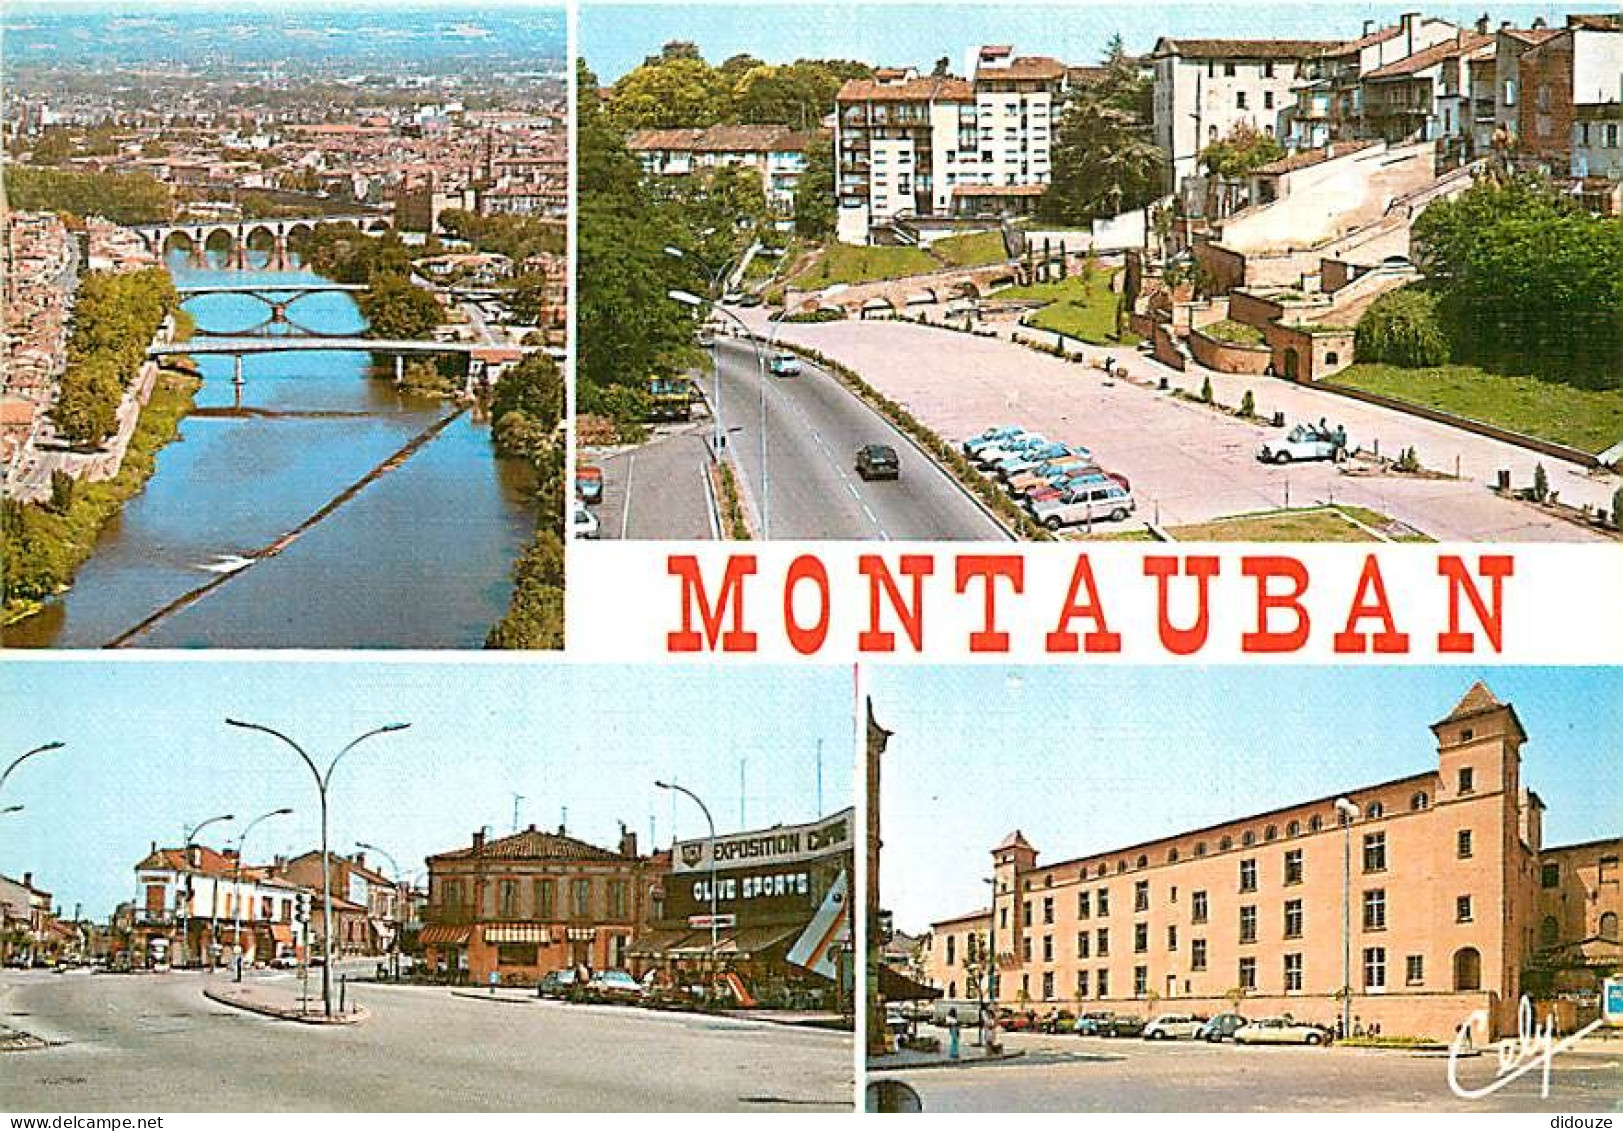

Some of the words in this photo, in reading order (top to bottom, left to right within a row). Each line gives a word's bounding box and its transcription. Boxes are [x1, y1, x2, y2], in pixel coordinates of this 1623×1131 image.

[714, 832, 800, 862] EXPOSITION
[693, 878, 736, 901] OLVE
[742, 873, 807, 899] SPORTS
